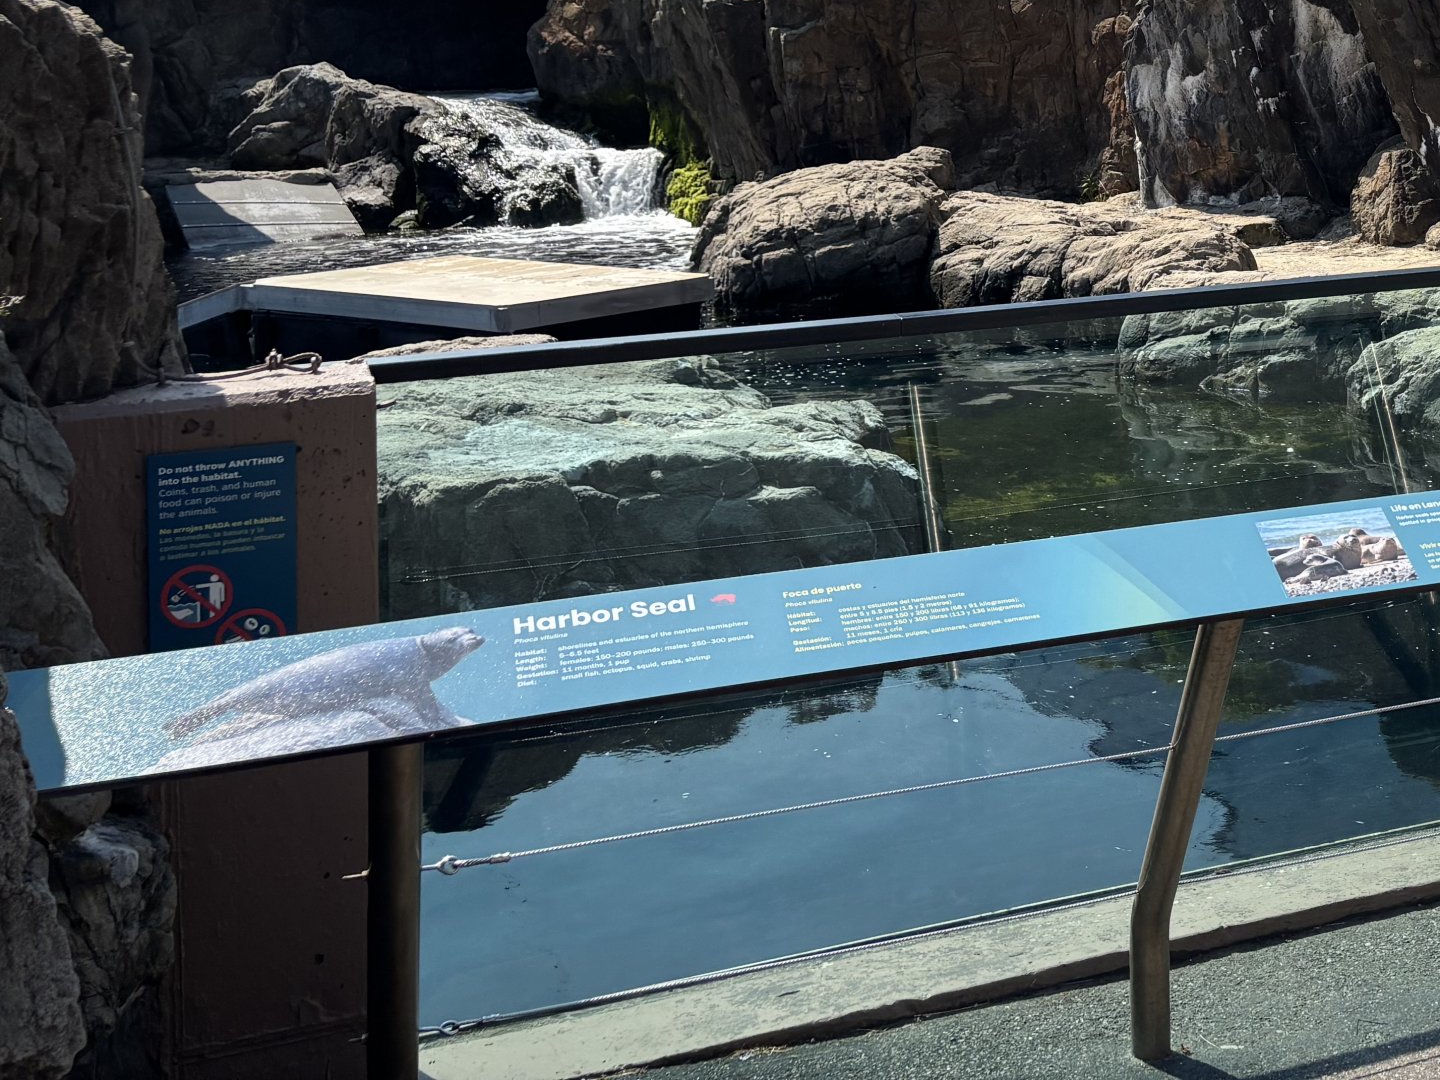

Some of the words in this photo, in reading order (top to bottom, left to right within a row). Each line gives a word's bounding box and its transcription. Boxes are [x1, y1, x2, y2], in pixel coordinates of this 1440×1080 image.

[159, 467, 173, 475] Do
[175, 464, 193, 473] not
[195, 463, 226, 471] throw
[228, 455, 285, 468] ANYTHING
[159, 477, 179, 486] into
[181, 475, 199, 484] the
[201, 471, 242, 481] habitat.
[222, 481, 240, 490] and
[243, 479, 276, 488] human
[159, 498, 181, 508] food
[205, 494, 238, 505] poison
[254, 489, 281, 499] injure
[160, 511, 175, 519] the
[178, 507, 218, 517] animals.
[1390, 504, 1407, 512] Life
[783, 590, 809, 598] Foca
[826, 582, 861, 594] puerto
[513, 607, 624, 635] Harbor
[630, 593, 696, 618] Seal
[558, 642, 597, 651] shorelines
[615, 634, 649, 643] estuaries
[674, 627, 705, 635] northern
[706, 621, 749, 631] hemisphere
[514, 649, 547, 657] Habitat:
[584, 647, 599, 655] feet
[515, 656, 546, 664] Length:
[516, 664, 547, 672] Weight:
